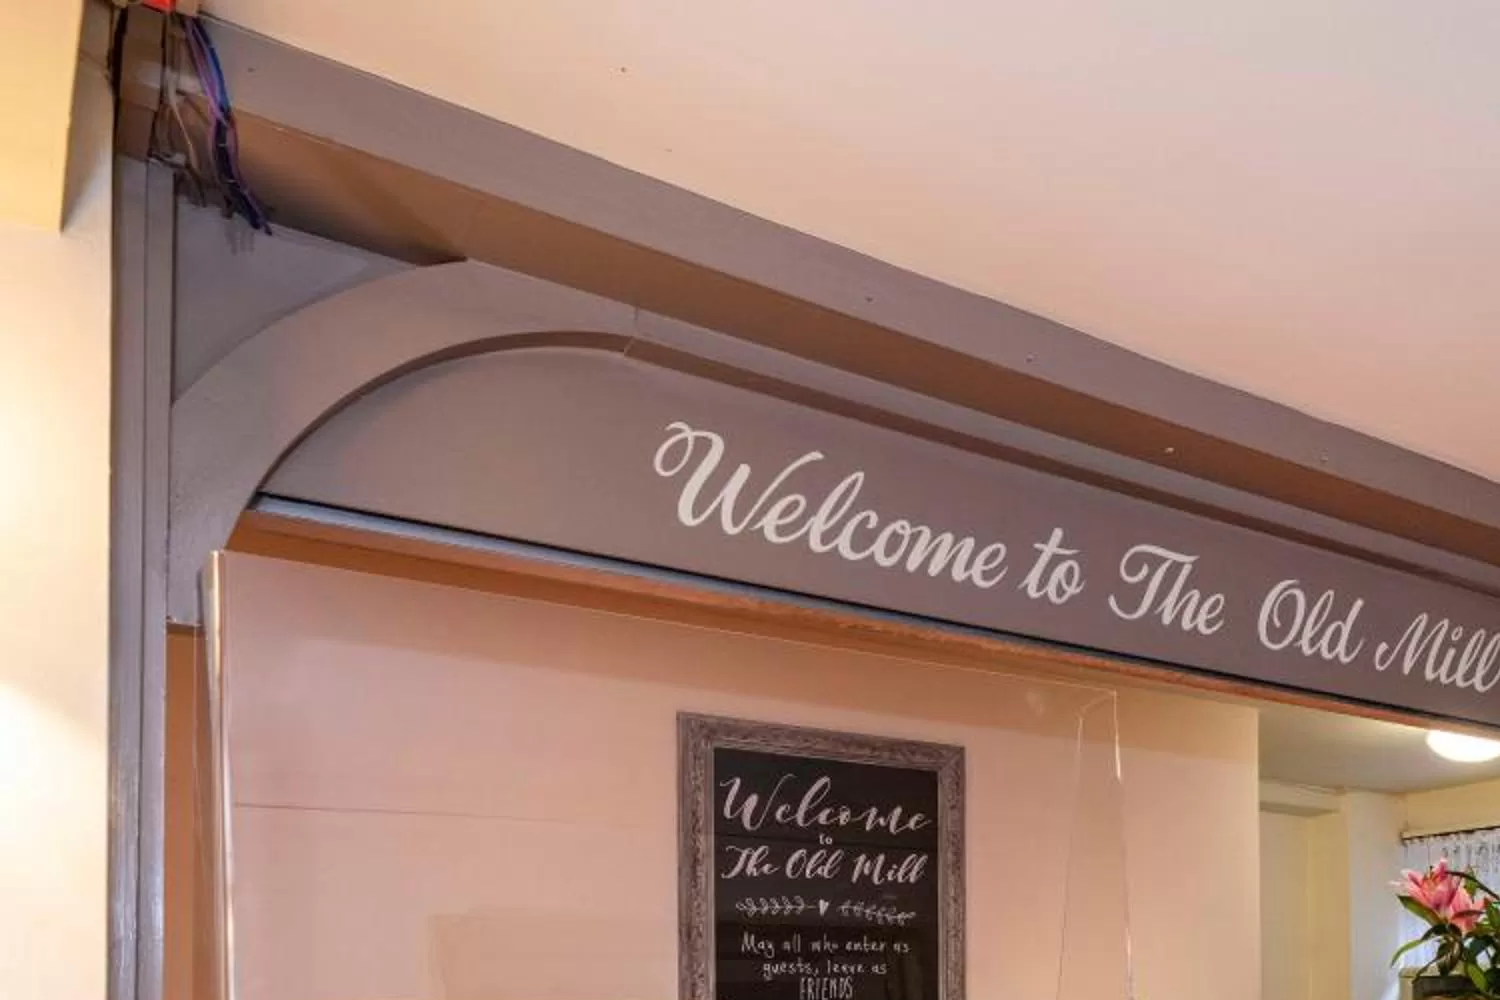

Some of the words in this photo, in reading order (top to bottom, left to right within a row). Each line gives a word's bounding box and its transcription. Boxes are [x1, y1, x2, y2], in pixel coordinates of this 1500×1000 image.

[653, 421, 1009, 589] Welcome
[1017, 526, 1087, 605] to
[1107, 543, 1226, 635] The
[1257, 578, 1365, 665] Old
[719, 773, 932, 835] Welcome
[819, 834, 833, 845] to
[721, 846, 779, 879] The
[785, 848, 844, 880] Old
[851, 853, 928, 886] Mill
[741, 931, 775, 959] May
[783, 933, 801, 951] all
[811, 932, 839, 952] who
[845, 935, 886, 952] enter
[893, 942, 910, 953] as
[763, 957, 819, 981] guests,
[871, 963, 887, 975] as
[800, 976, 853, 1000] FRIENDS
